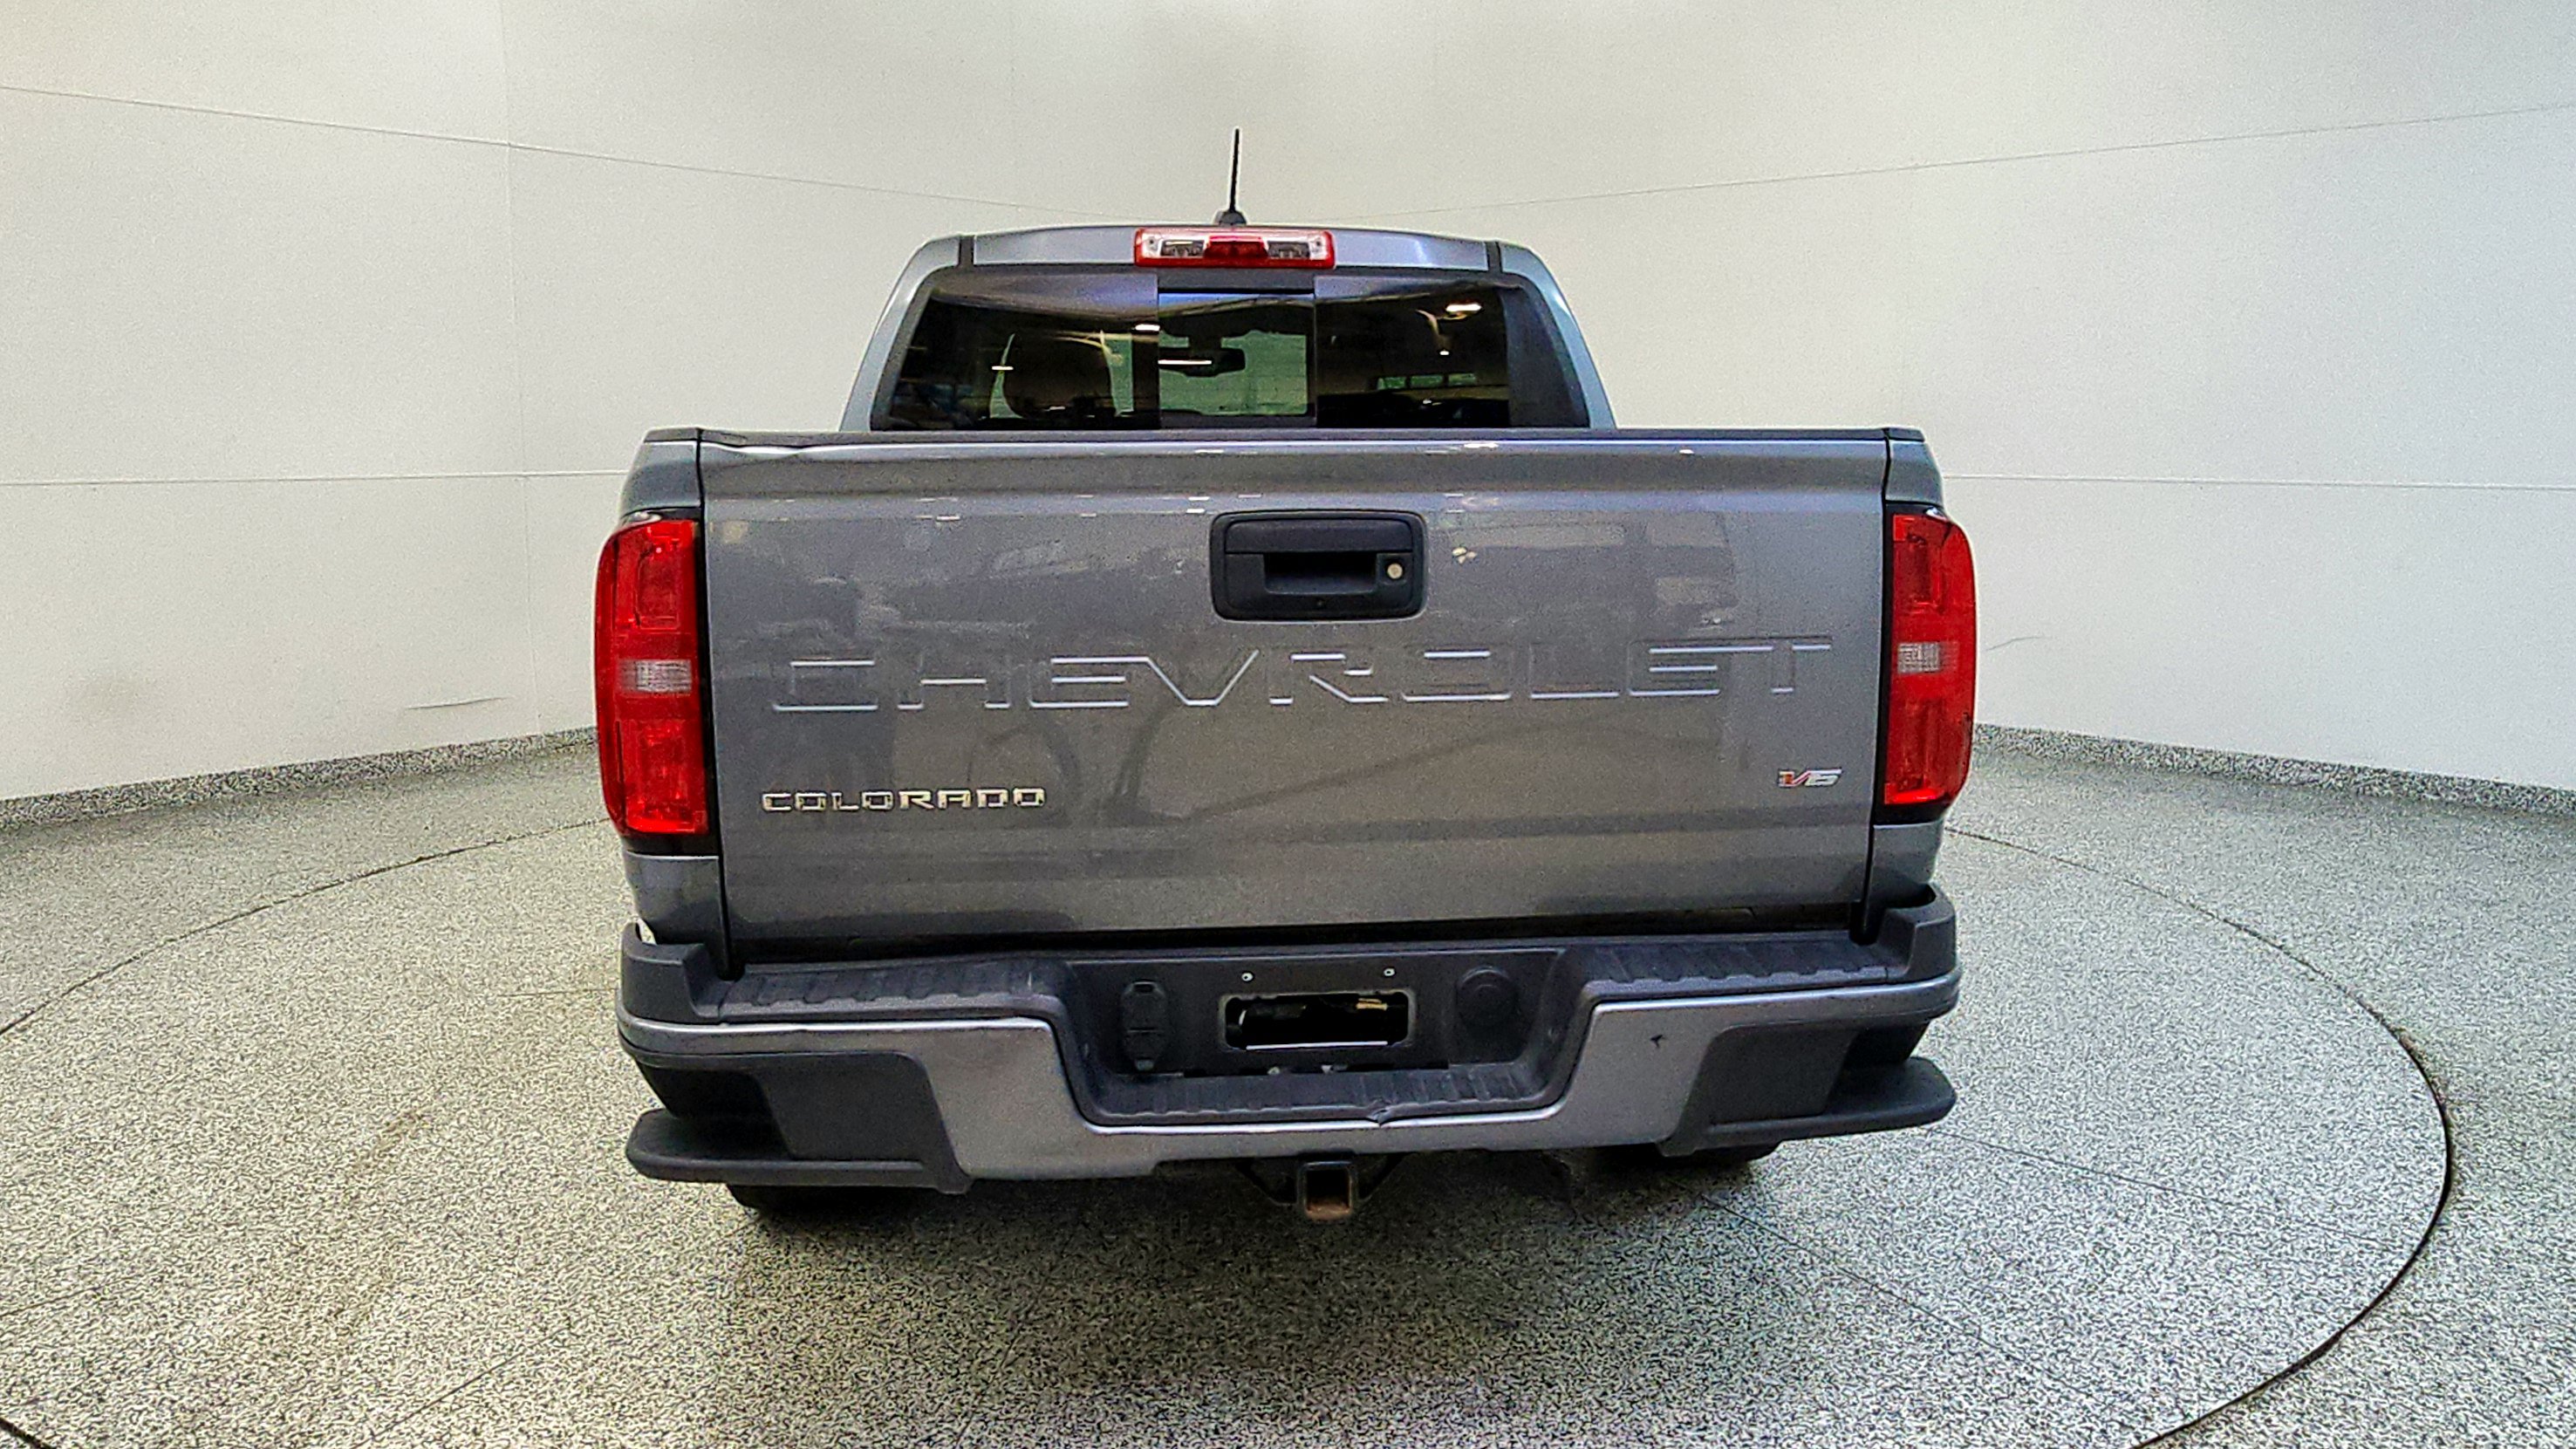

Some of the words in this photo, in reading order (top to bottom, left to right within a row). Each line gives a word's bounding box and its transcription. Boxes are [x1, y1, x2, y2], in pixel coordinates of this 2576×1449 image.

[771, 636, 1832, 711] CHEVROLET
[1778, 768, 1842, 788] V6
[762, 787, 1046, 811] COLORADO
